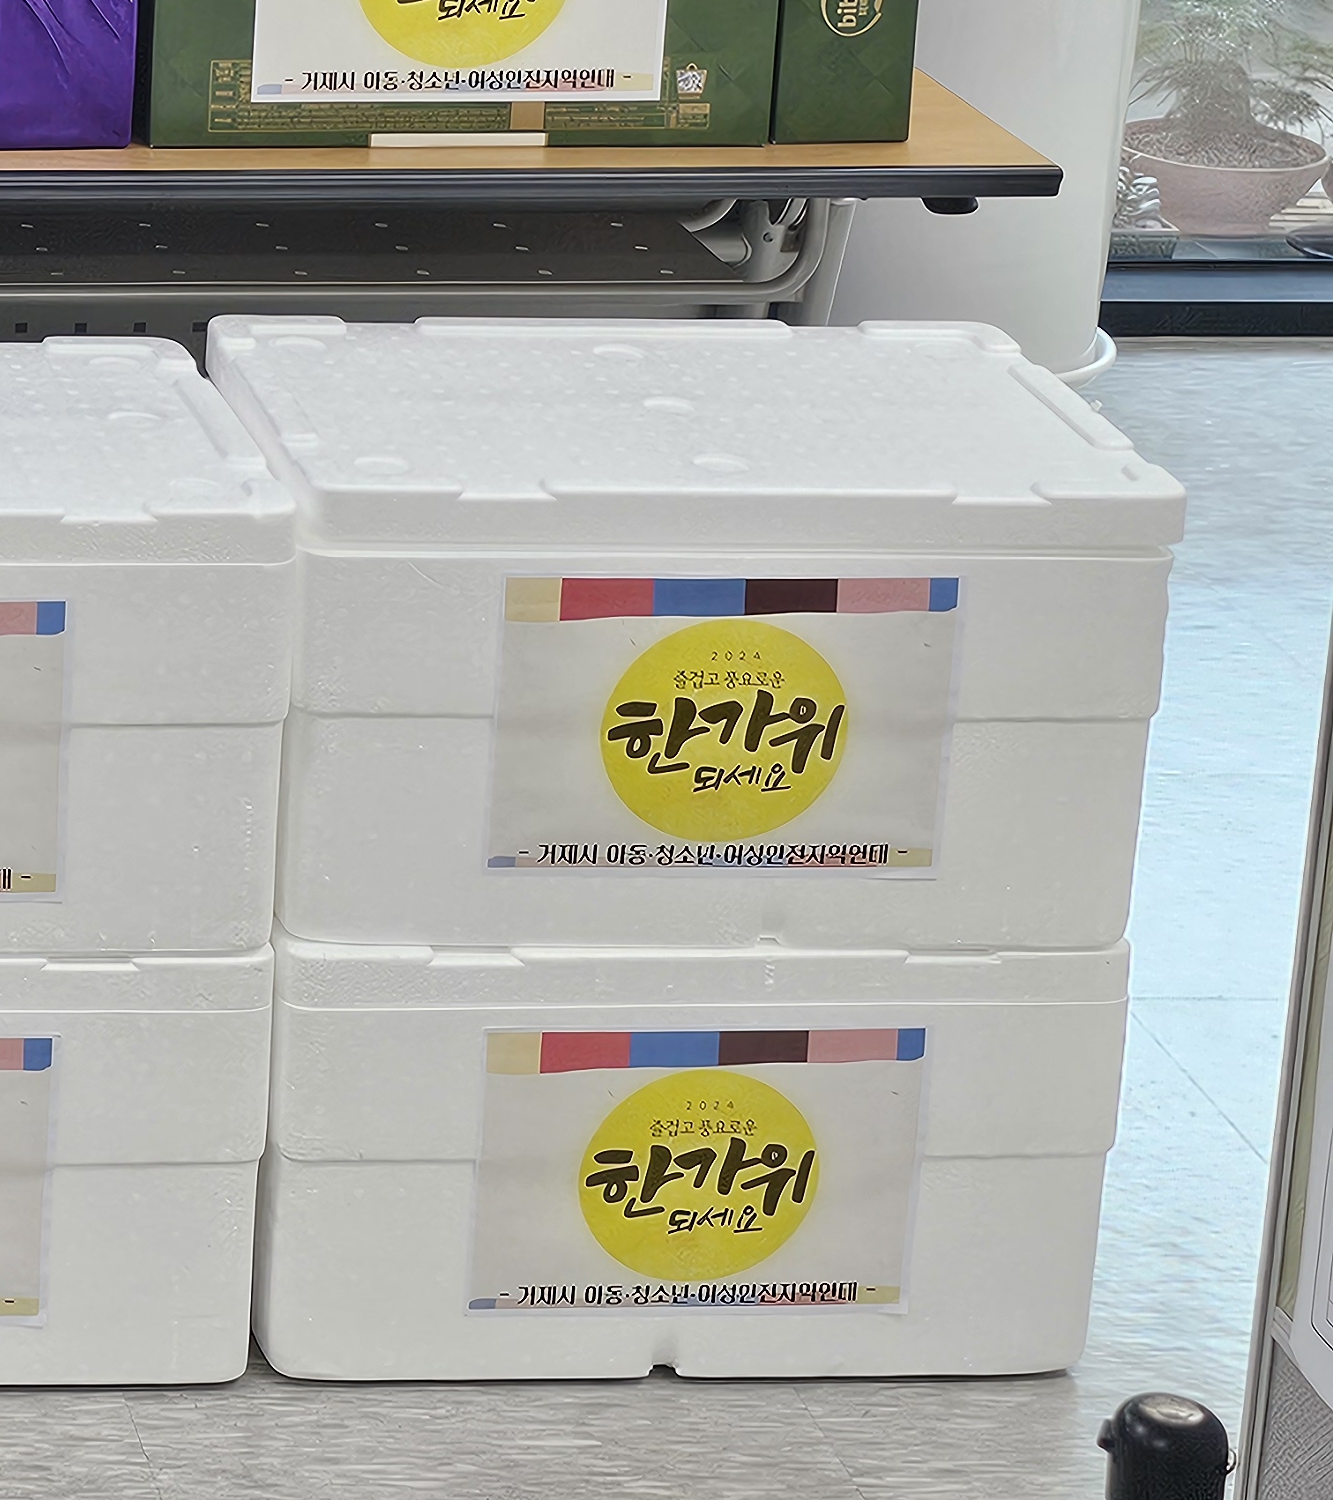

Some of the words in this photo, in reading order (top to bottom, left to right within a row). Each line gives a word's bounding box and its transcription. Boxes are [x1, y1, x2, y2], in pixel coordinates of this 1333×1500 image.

[301, 71, 355, 91] 거제시
[711, 651, 762, 661] 2024
[608, 690, 845, 774] 한가위
[693, 766, 791, 793] 되세요
[537, 844, 598, 865] 거제시
[686, 1100, 735, 1111] 2024
[585, 1137, 815, 1217] 한가위
[668, 1207, 762, 1234] 되세요
[517, 1285, 577, 1306] 거제시
